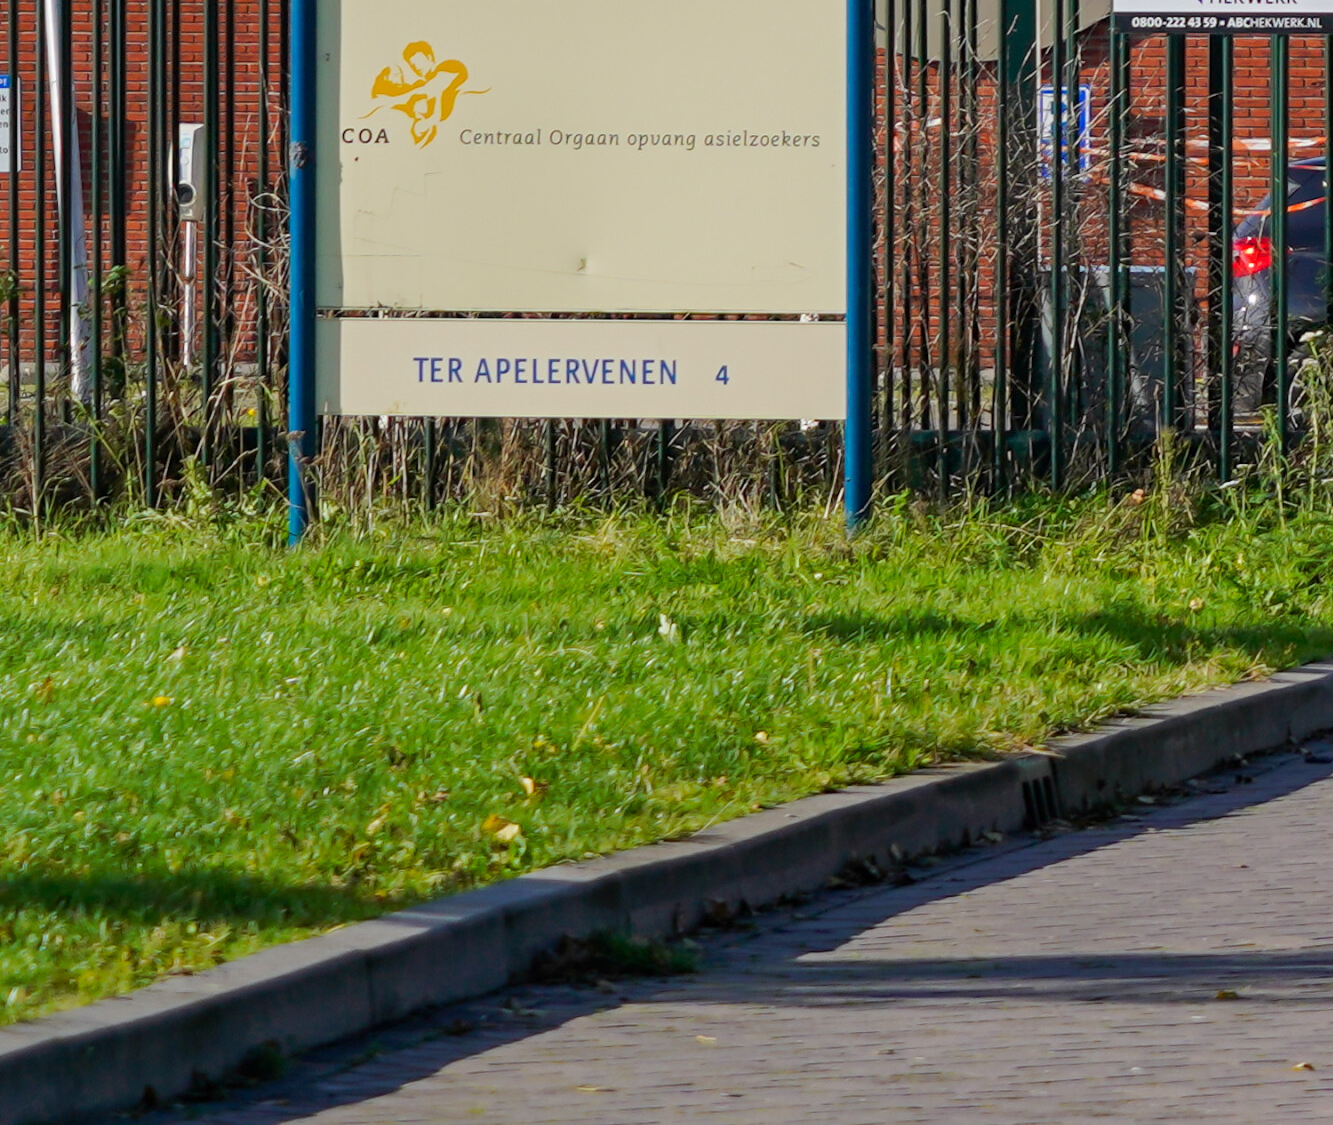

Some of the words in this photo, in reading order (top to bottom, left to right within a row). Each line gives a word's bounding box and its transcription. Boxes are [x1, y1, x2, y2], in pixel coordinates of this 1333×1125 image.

[1131, 16, 1186, 28] 0800-222
[1227, 17, 1322, 28] ABCHEKWERK.NL
[342, 128, 390, 144] COA
[459, 128, 542, 145] Centraal
[549, 129, 620, 150] Orgaan
[627, 133, 697, 151] opvang
[704, 129, 821, 148] asielzoekers
[413, 357, 463, 383] TER
[473, 358, 677, 385] APELERVENEN
[714, 365, 730, 385] 4
